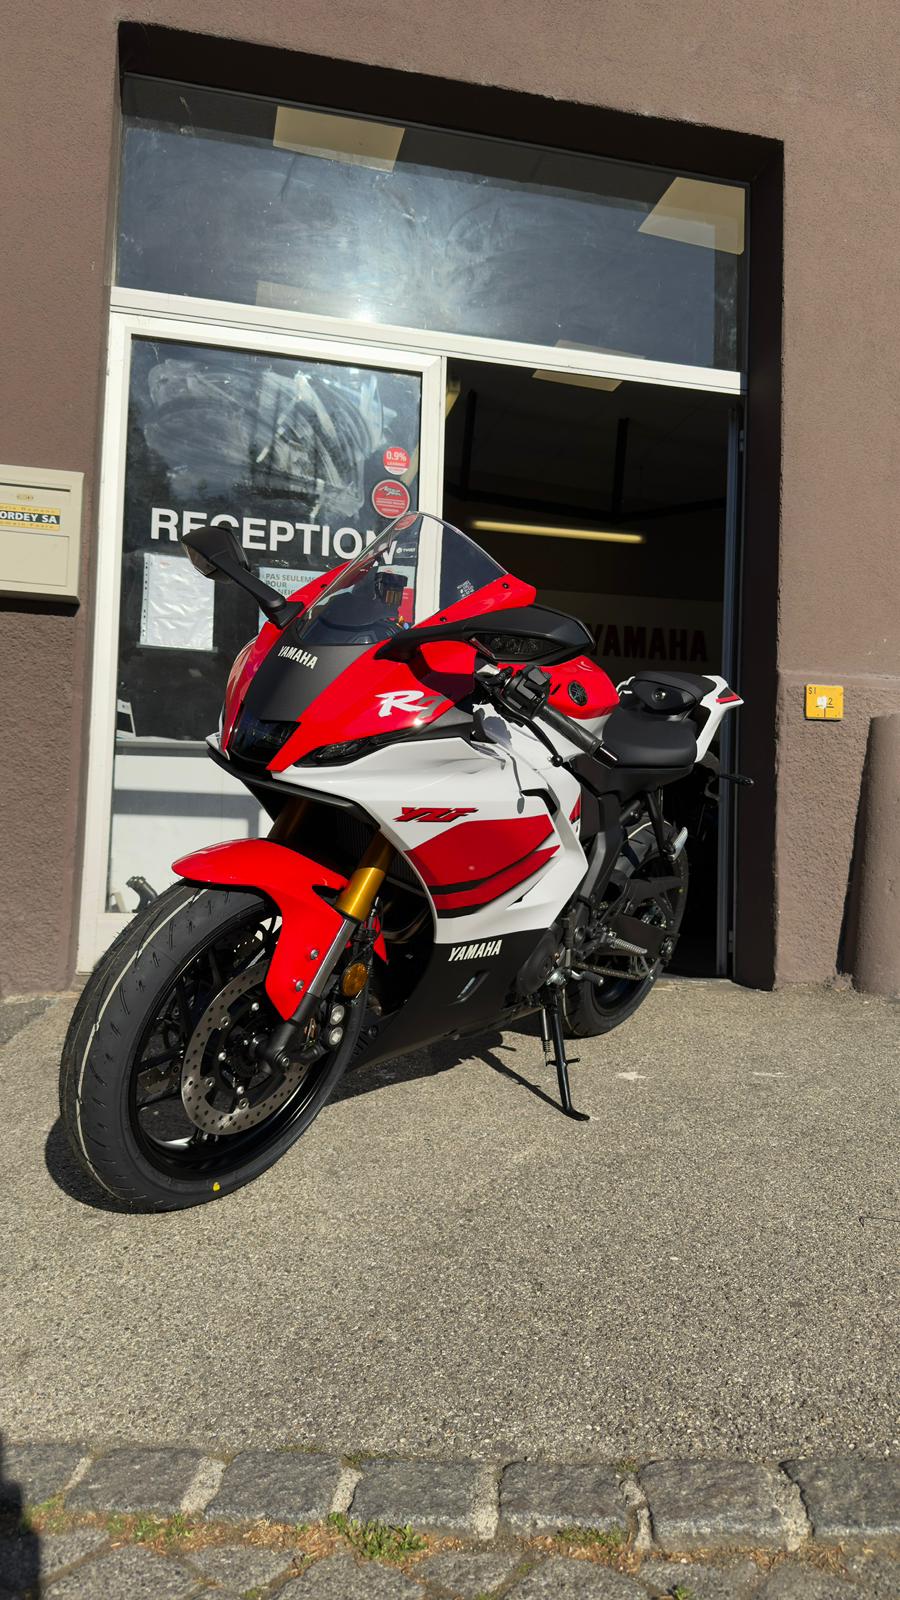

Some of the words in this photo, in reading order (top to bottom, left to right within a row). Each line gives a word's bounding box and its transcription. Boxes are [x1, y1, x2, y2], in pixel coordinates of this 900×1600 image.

[386, 450, 407, 463] 0.9%
[41, 514, 57, 524] SA
[265, 573, 280, 581] PAS
[265, 580, 287, 589] POUR
[586, 623, 708, 662] YAMAHA
[277, 645, 318, 670] YAMAHA
[393, 806, 479, 822] YZF
[448, 939, 502, 962] YAMAHA
